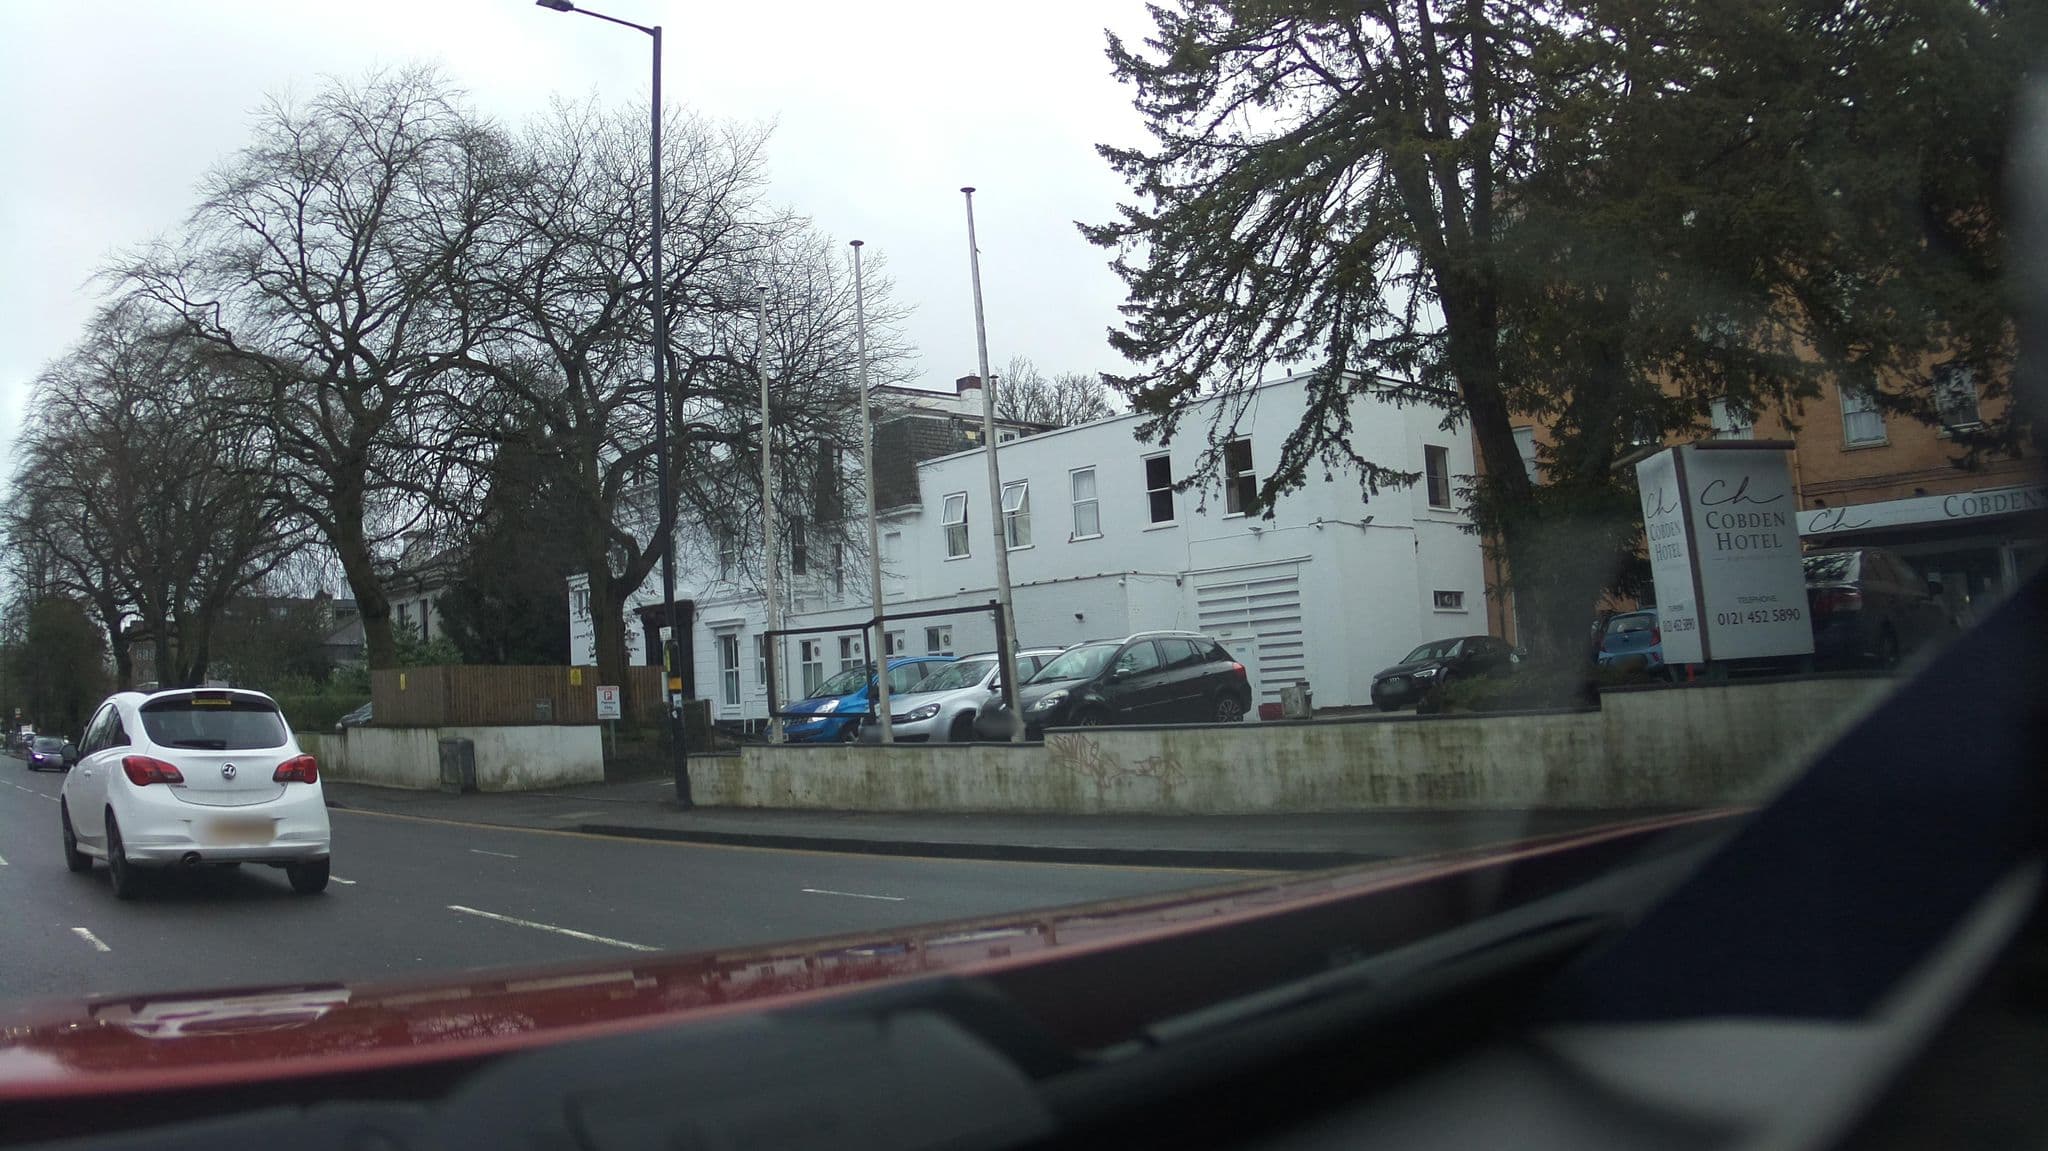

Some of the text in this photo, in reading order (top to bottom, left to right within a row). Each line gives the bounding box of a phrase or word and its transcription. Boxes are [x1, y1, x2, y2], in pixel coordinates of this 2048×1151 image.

[1944, 492, 2036, 518] COBDEN
[1706, 511, 1786, 530] COBDEN
[1649, 519, 1681, 542] COBDEN
[1717, 532, 1783, 551] HOTEL
[1655, 542, 1683, 562] HOTEL
[1717, 608, 1801, 626] 0121 452 5890
